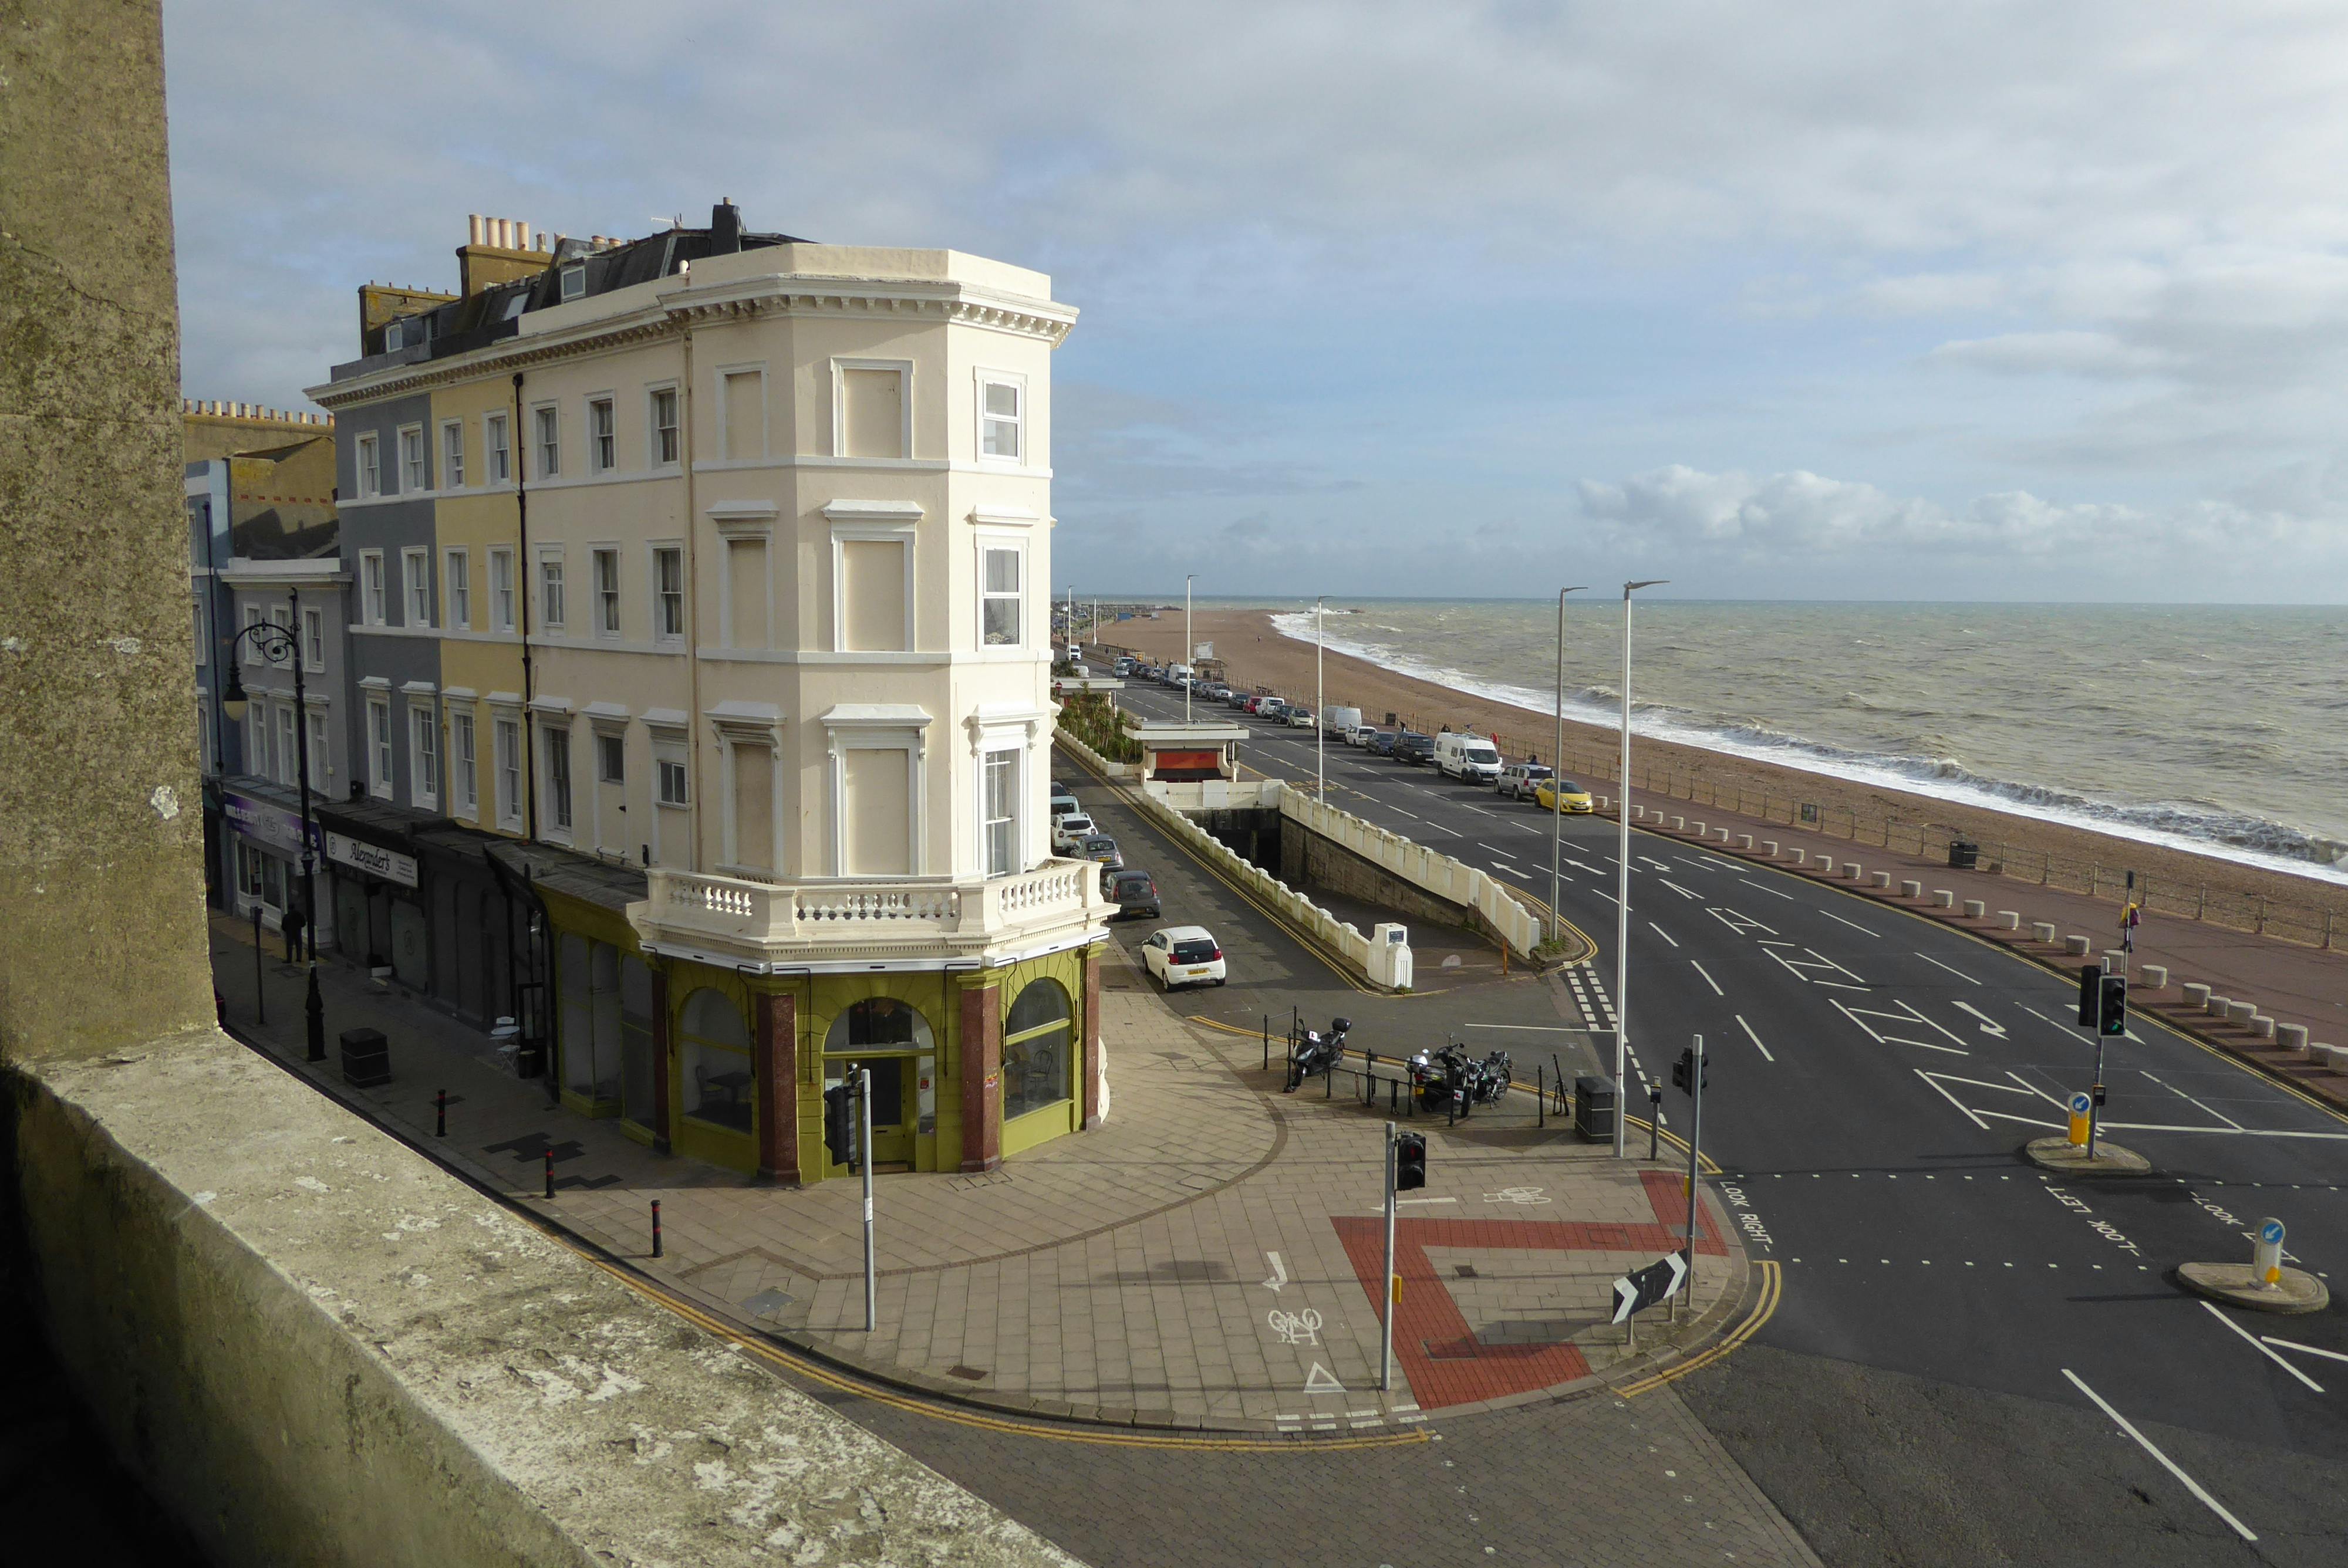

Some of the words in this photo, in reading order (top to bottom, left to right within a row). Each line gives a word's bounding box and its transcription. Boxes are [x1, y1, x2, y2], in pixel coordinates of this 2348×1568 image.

[349, 842, 390, 871] Alexander's
[1719, 1181, 1750, 1207] LOOK
[1738, 1214, 1773, 1244] RIGHT
[2045, 1186, 2093, 1213] LEFT
[2192, 1198, 2245, 1225] LOOK
[2086, 1220, 2137, 1249] LOOK
